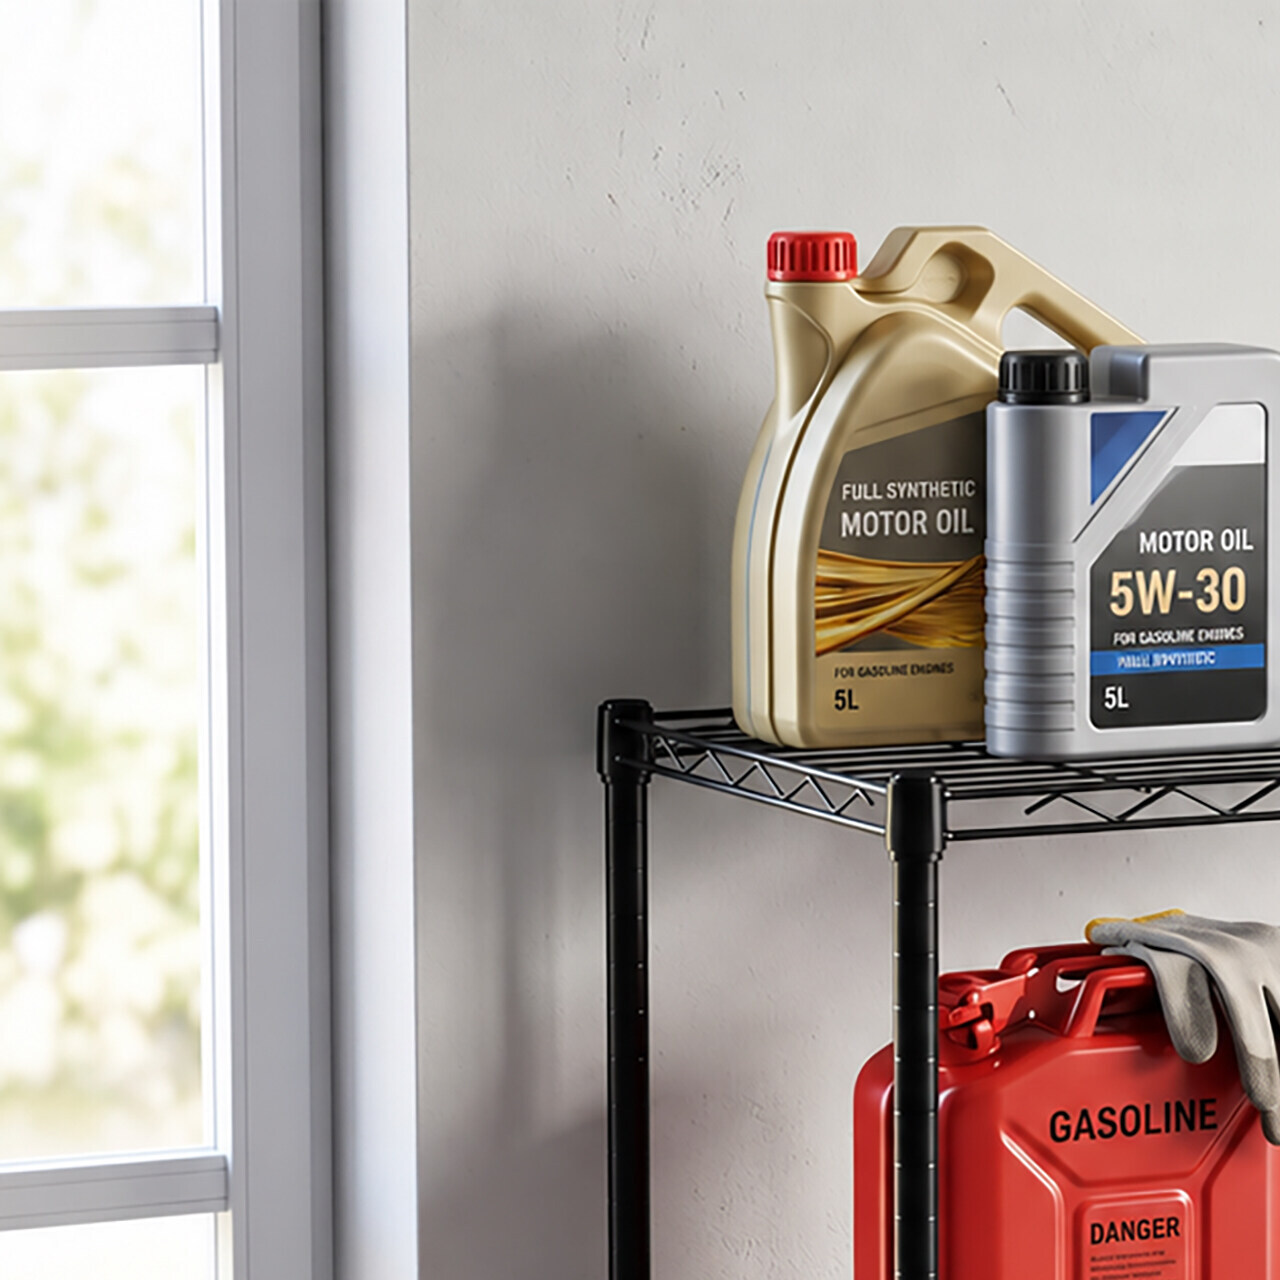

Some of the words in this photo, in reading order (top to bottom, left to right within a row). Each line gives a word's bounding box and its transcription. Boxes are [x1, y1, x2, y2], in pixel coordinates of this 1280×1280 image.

[842, 482, 883, 501] FULL
[886, 480, 976, 499] SYNTHETIC
[841, 510, 928, 538] MOTOR
[936, 507, 975, 534] OIL
[1140, 529, 1214, 554] MOTOR
[1220, 528, 1254, 551] OIL
[1109, 566, 1246, 617] 5W-30
[834, 688, 860, 712] 5L
[1104, 686, 1130, 710] 5L
[1049, 1098, 1219, 1143] GASOLINE
[1090, 1216, 1181, 1246] DANGER
